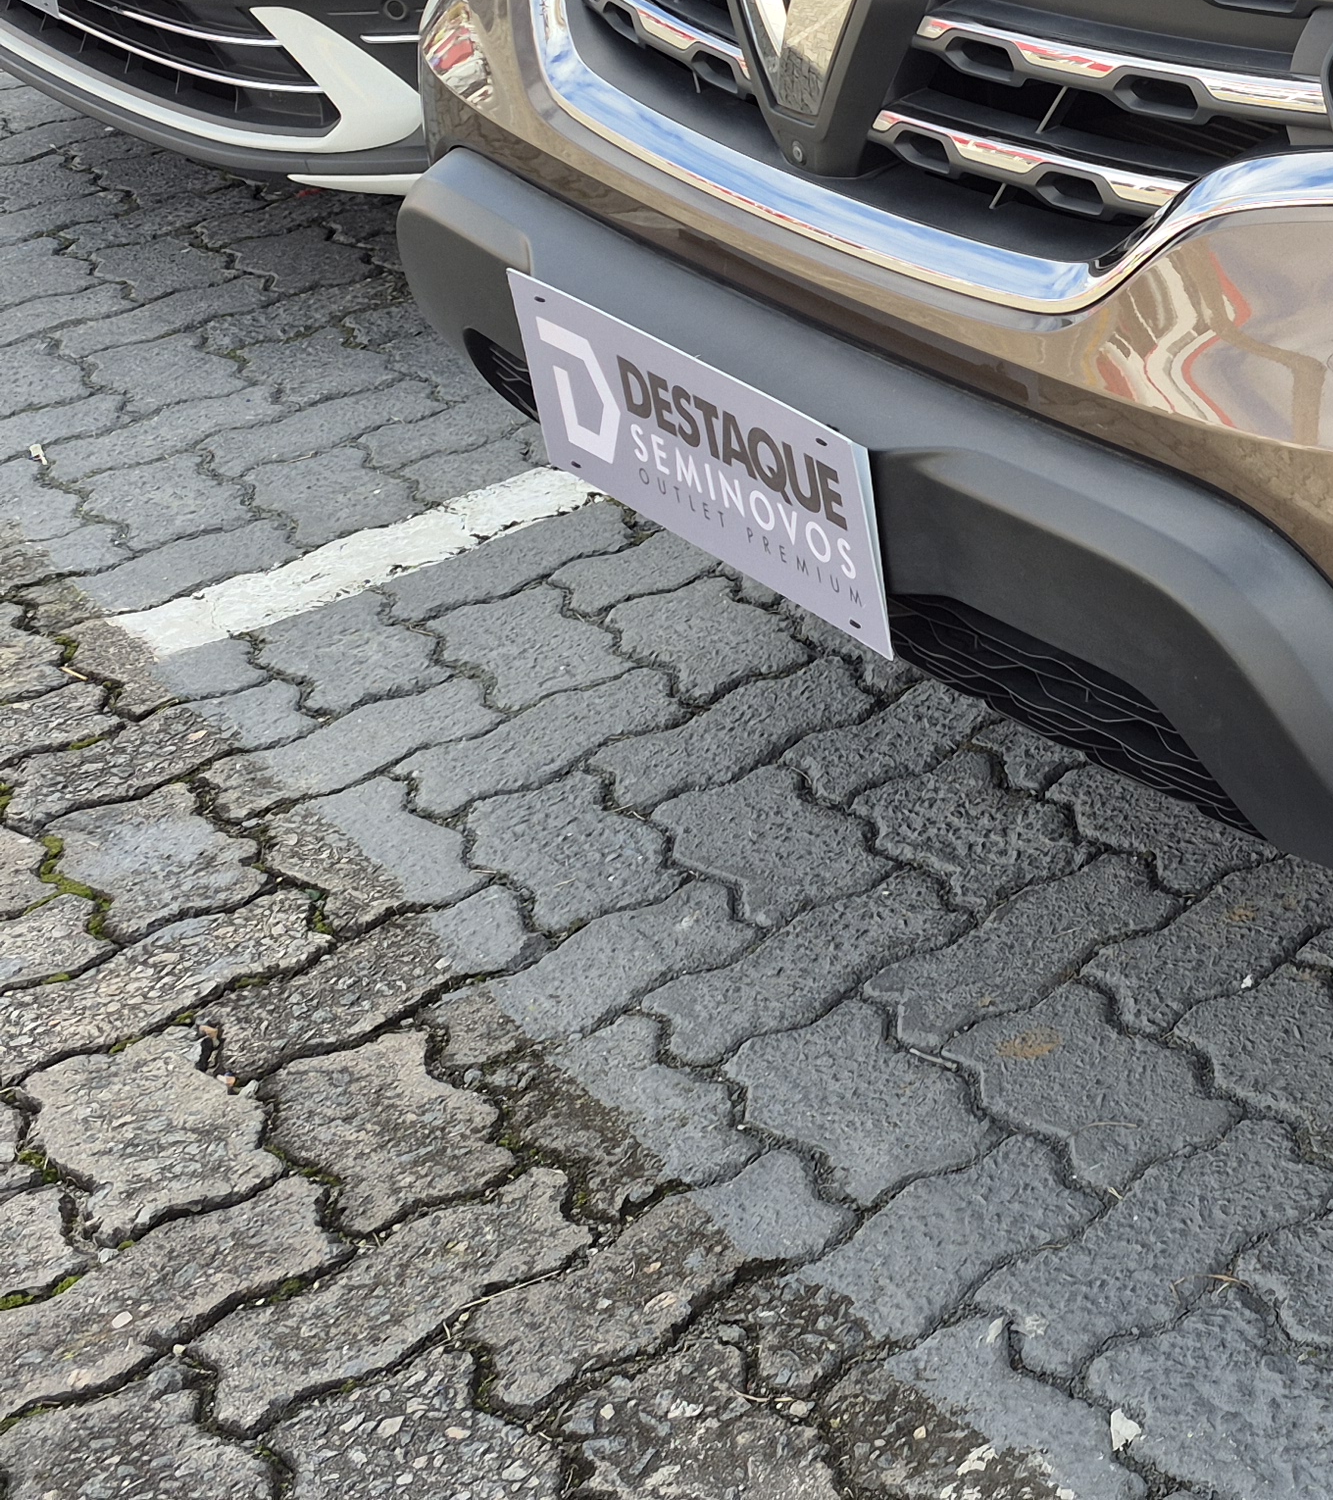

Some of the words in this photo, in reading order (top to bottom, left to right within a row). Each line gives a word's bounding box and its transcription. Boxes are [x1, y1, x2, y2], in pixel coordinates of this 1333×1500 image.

[616, 354, 849, 531] DESTAQUE
[629, 423, 858, 581] SEMINOVOS
[638, 466, 726, 530] OUTLET
[745, 526, 864, 609] PREMIUM
